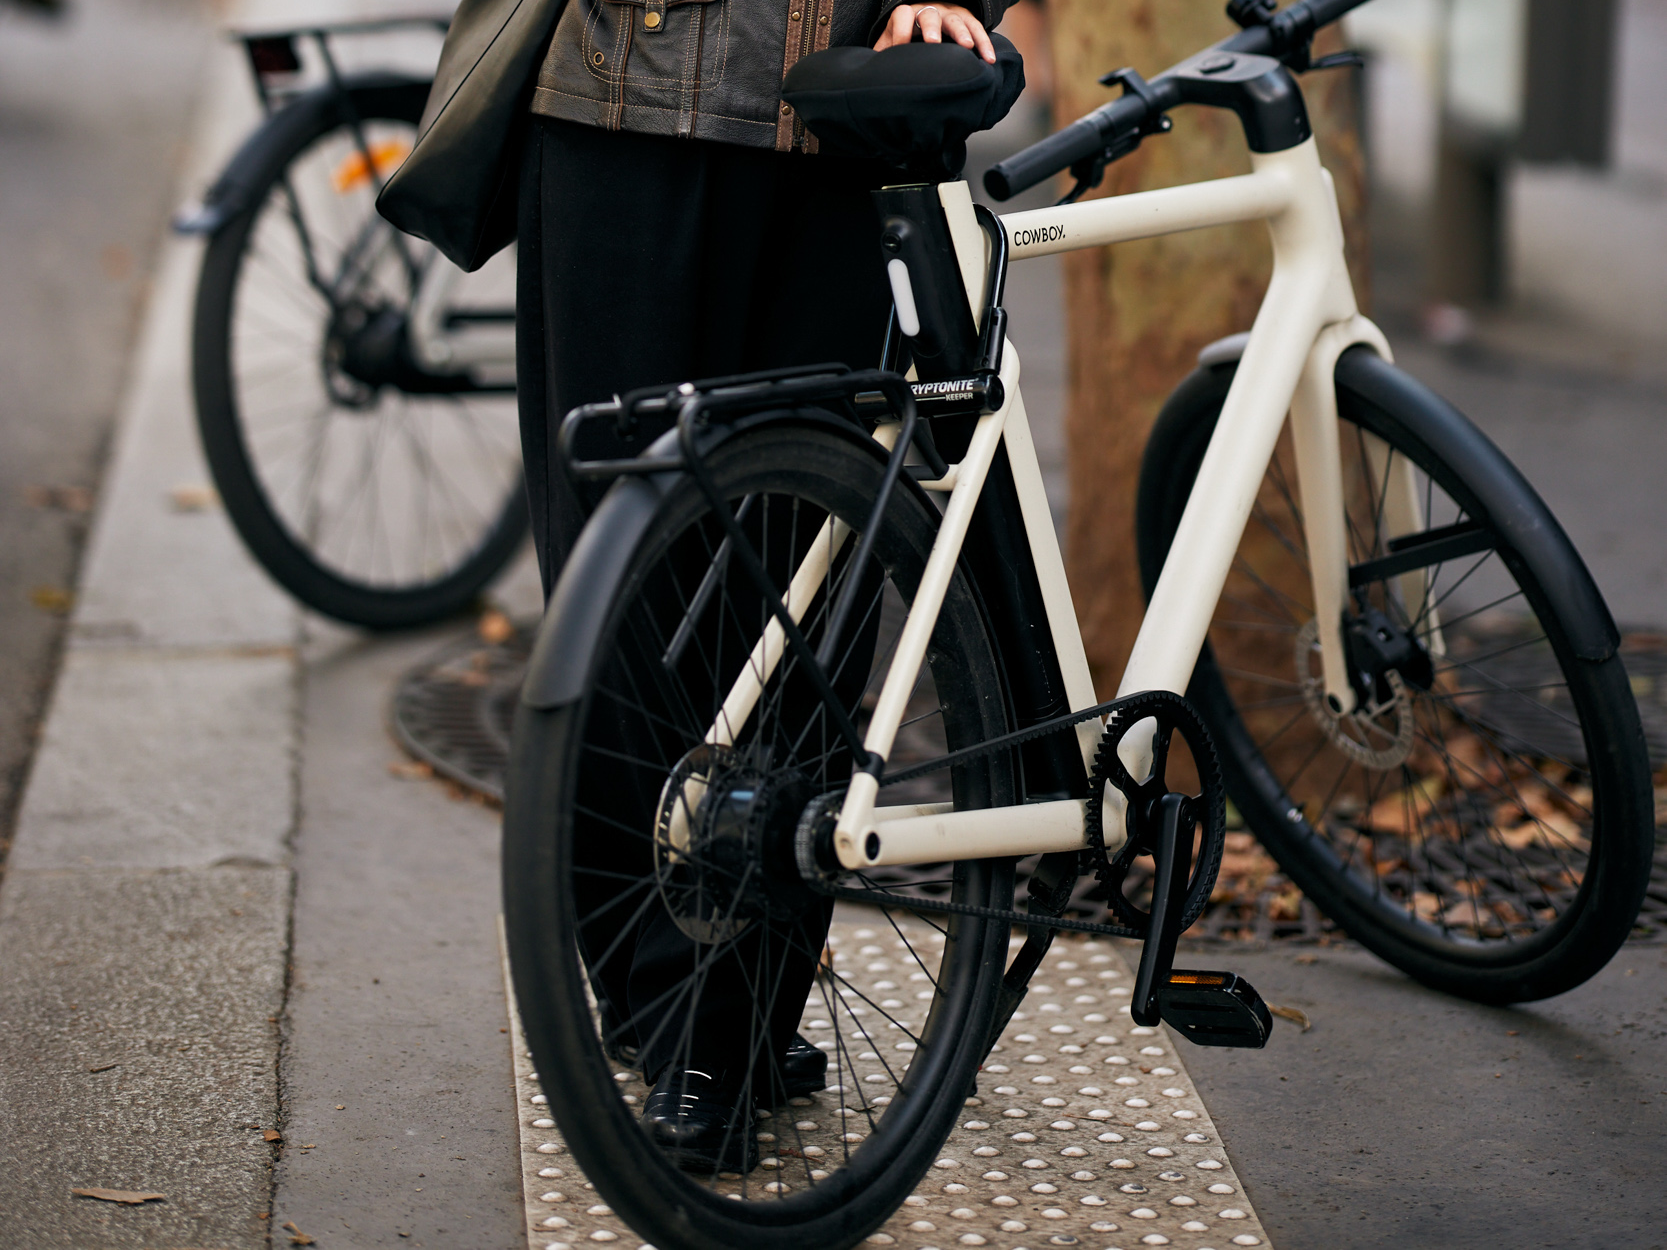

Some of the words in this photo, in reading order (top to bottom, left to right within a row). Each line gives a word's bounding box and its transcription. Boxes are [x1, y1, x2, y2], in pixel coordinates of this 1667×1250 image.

[1014, 224, 1066, 247] COWBOY.
[911, 379, 974, 395] RYPTONITE
[945, 392, 974, 402] KEEPER
